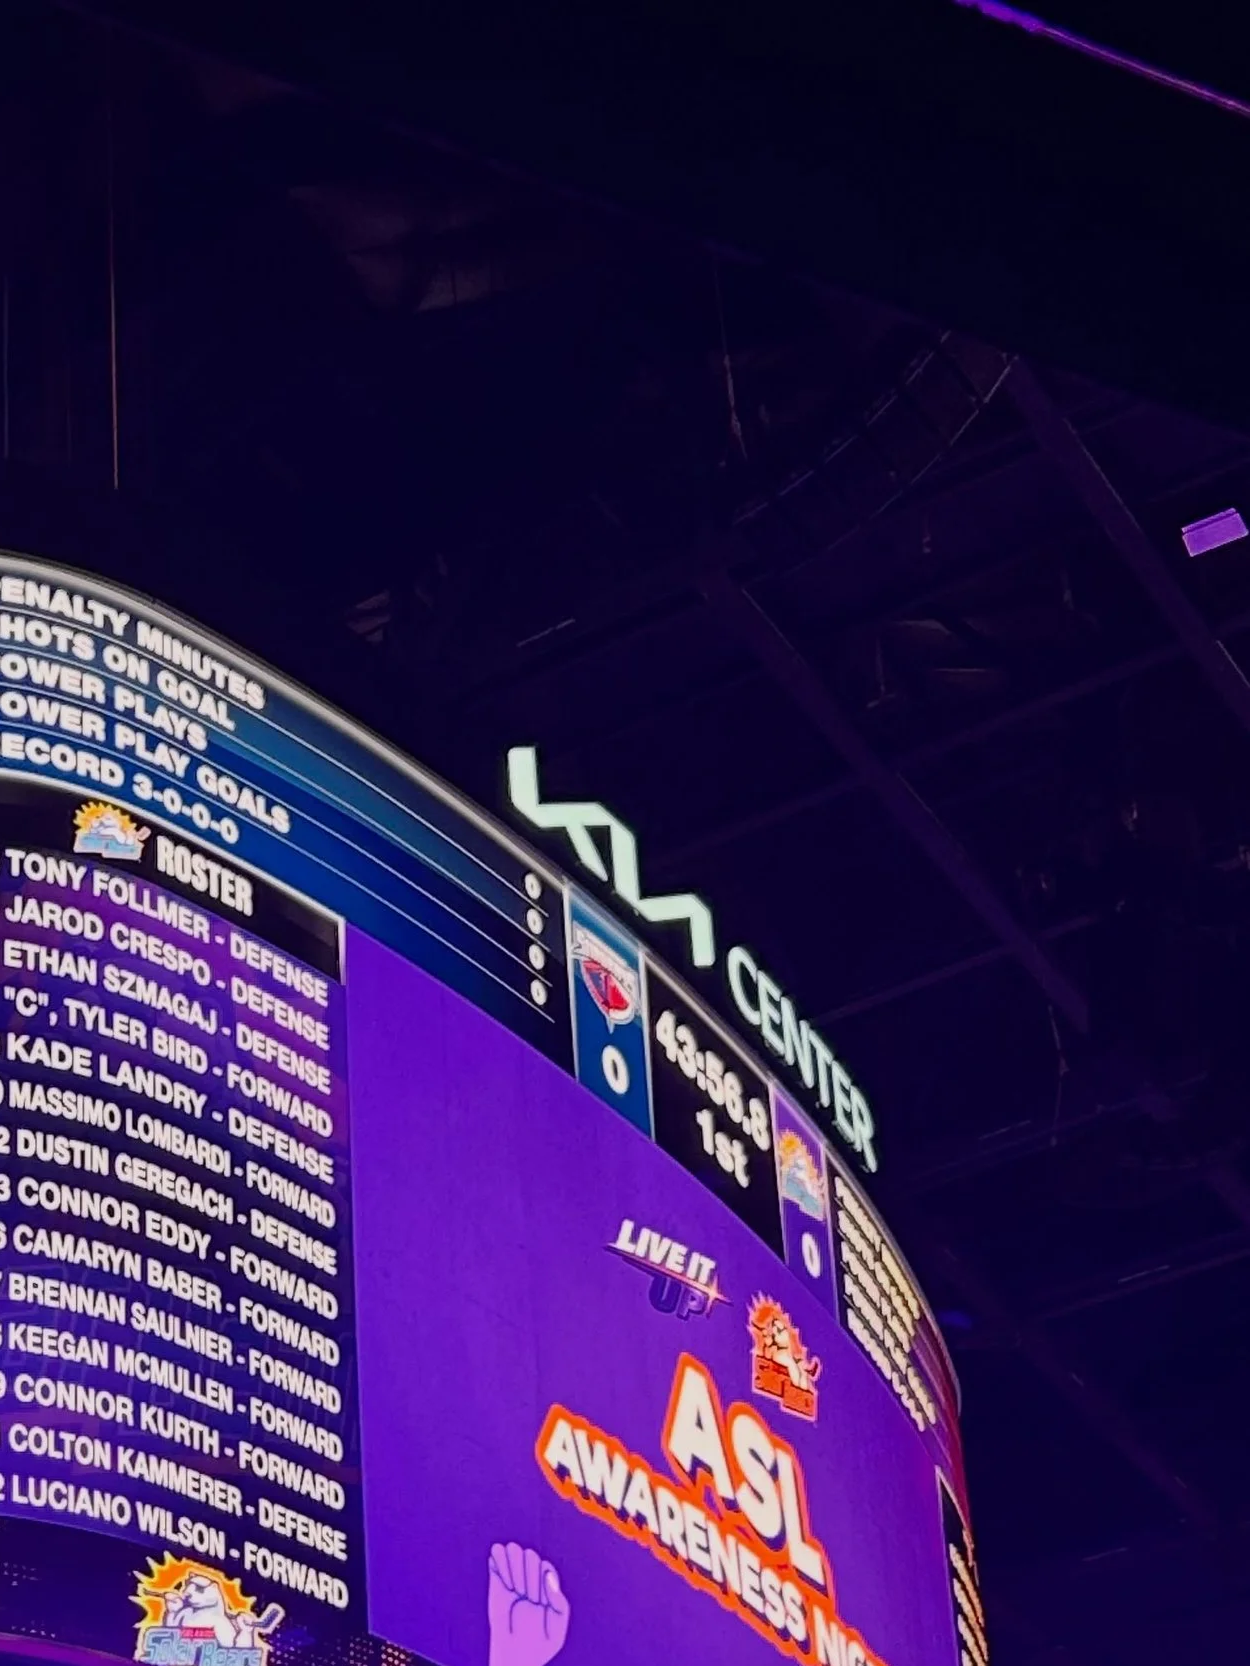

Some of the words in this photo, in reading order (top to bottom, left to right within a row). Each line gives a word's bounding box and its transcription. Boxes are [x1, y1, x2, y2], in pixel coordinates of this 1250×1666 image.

[102, 644, 149, 685] ON
[157, 668, 236, 732] GOAL
[114, 689, 209, 751] PLAYS
[137, 621, 265, 711] MINUTES
[114, 724, 191, 778] PLAY
[196, 765, 291, 834] GOALS
[133, 773, 238, 844] 3-0-0-0
[5, 849, 87, 891] TONY
[93, 868, 210, 944] FOLLMER
[230, 928, 328, 1006] DEFENSE
[157, 835, 253, 916] ROSTER
[524, 872, 541, 900] 0
[526, 908, 543, 935] 0
[4, 941, 97, 985] ETHAN
[103, 966, 217, 1035] SZMAGAJ
[236, 1023, 331, 1094] DEFENSE
[5, 896, 104, 940] JAROD
[110, 922, 210, 986] CRESPO
[231, 976, 329, 1050] DEFENSE
[528, 943, 545, 970] 0
[530, 979, 547, 1006] 0
[7, 1032, 92, 1077] KADE
[100, 1054, 207, 1121] LANDRY
[230, 1108, 333, 1184] DEFENSE
[63, 997, 146, 1050] TYLER
[152, 1036, 207, 1075] BIRD
[228, 1064, 332, 1137] FORWARD
[602, 1045, 629, 1095] 0
[656, 1010, 771, 1152] 43:56.8
[727, 946, 877, 1173] CENTER
[9, 1080, 120, 1131] MASSIMO
[126, 1108, 231, 1178] LOMBARDI
[247, 1161, 334, 1228] FORWARD
[17, 1128, 109, 1177] DUSTIN
[115, 1153, 233, 1224] GEREGACH
[251, 1209, 336, 1275] DEFENSE
[696, 1109, 749, 1188] 1st
[13, 1224, 141, 1282] CAMARYN
[147, 1258, 221, 1314] BABER
[240, 1297, 339, 1367] FORWARD
[18, 1177, 138, 1235] CONNOR
[146, 1210, 210, 1260] EDDY
[231, 1247, 338, 1320] FORWARD
[616, 1218, 685, 1276] LIVE
[686, 1251, 716, 1285] IT
[802, 1232, 821, 1279] 0
[8, 1323, 108, 1370] KEEGAN
[115, 1346, 233, 1414] MCMULLEN
[251, 1397, 342, 1462] FORWARD
[9, 1273, 125, 1325] BRENNAN
[131, 1301, 232, 1366] SAULNIER
[250, 1350, 341, 1414] FORWARD
[9, 1423, 111, 1470] COLTON
[117, 1445, 241, 1517] KAMMERER
[258, 1498, 347, 1561] DEFENSE
[14, 1374, 133, 1427] CONNOR
[140, 1402, 219, 1457] KURTH
[239, 1442, 344, 1510] FORWARD
[670, 1365, 825, 1587] ASL
[12, 1474, 131, 1526] LUCIANO
[137, 1501, 226, 1560] WILSON
[244, 1541, 348, 1610] FORWARD
[544, 1418, 806, 1644] AWARENESS
